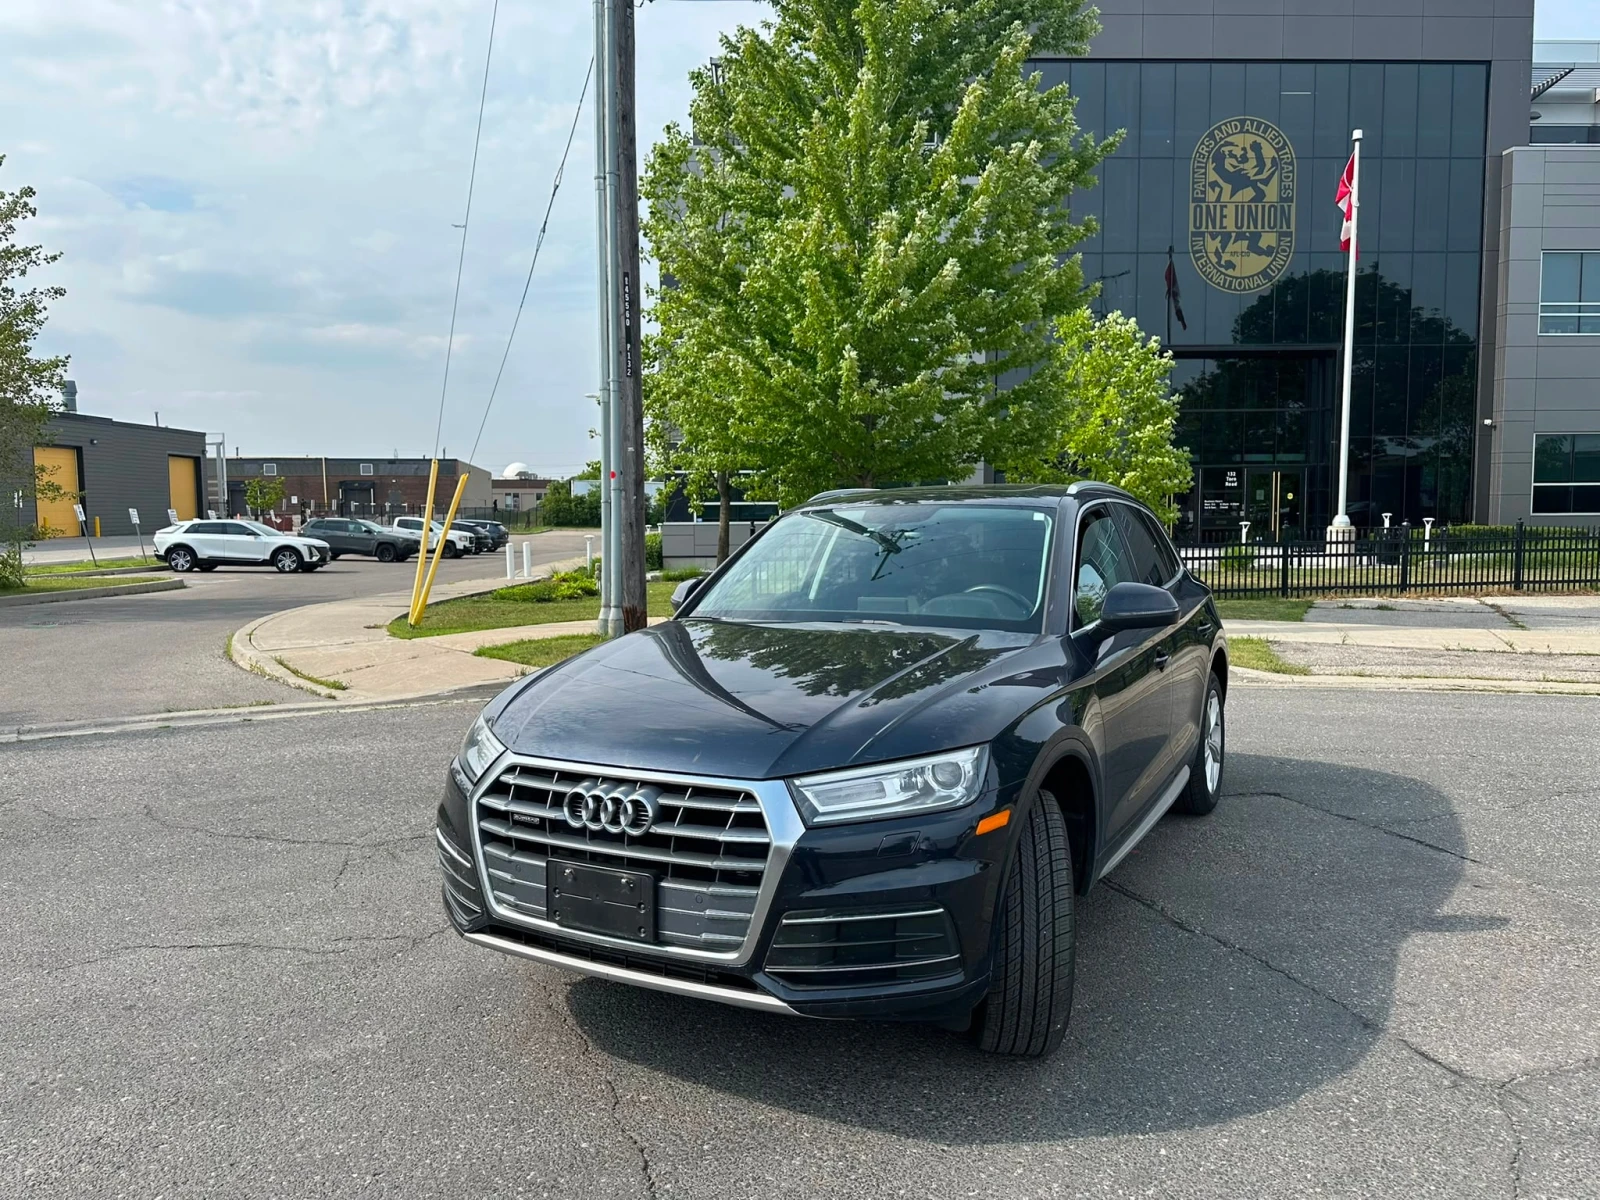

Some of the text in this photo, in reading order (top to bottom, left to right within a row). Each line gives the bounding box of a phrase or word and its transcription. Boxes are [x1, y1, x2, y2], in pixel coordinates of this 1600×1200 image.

[1193, 120, 1293, 198] PAINTERS AND ALLIED TRADES
[1193, 204, 1292, 230] ONE UNION
[1192, 236, 1291, 290] INTERNATIONAL UNION
